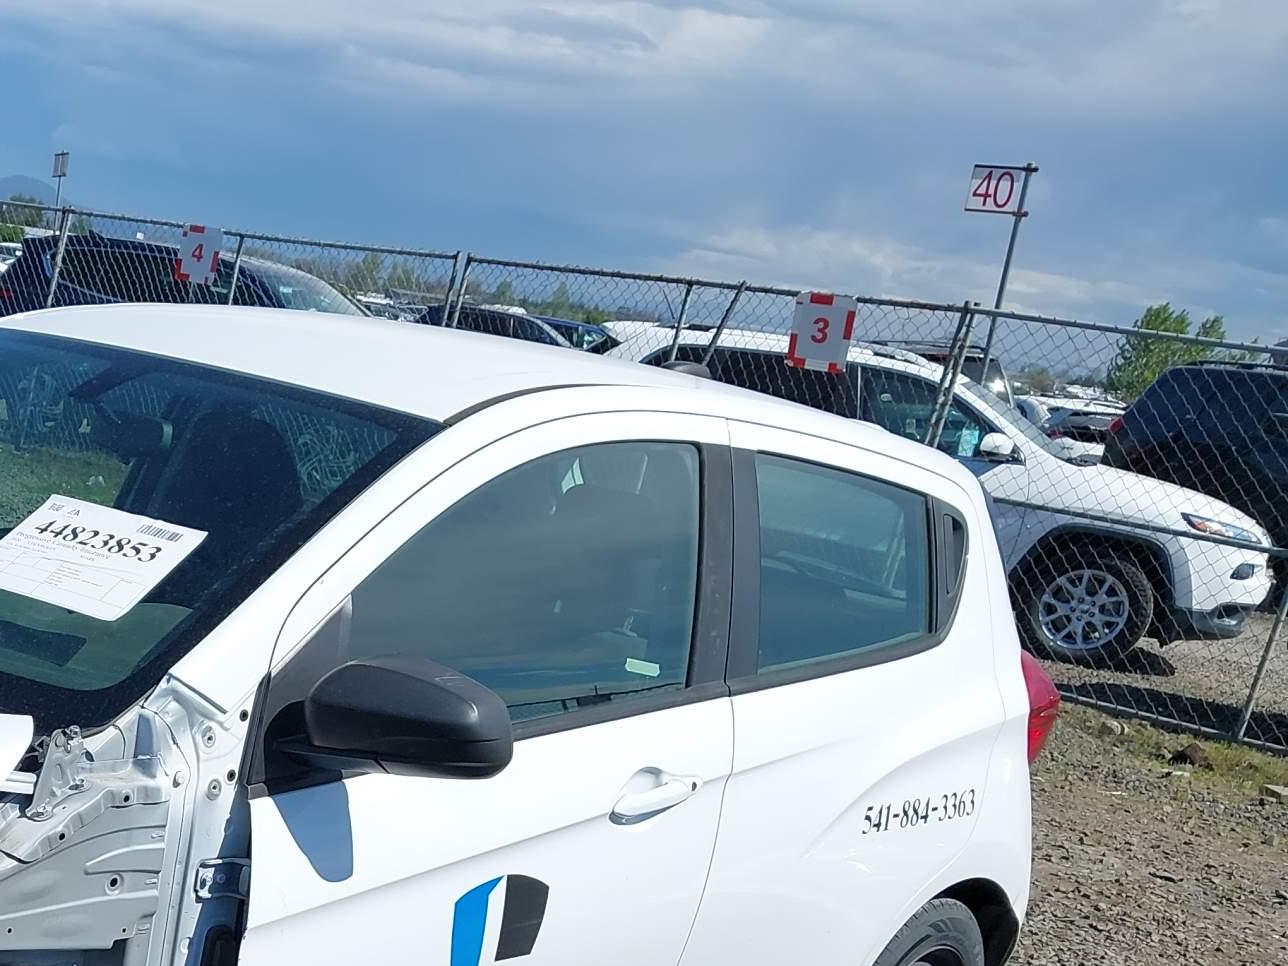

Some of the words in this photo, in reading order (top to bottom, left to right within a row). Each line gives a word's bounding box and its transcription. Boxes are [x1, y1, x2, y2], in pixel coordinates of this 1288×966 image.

[971, 169, 1016, 209] 40
[191, 243, 204, 262] 4
[809, 317, 830, 344] 3
[34, 519, 164, 562] 44823853
[861, 788, 976, 835] 541-884-3363
